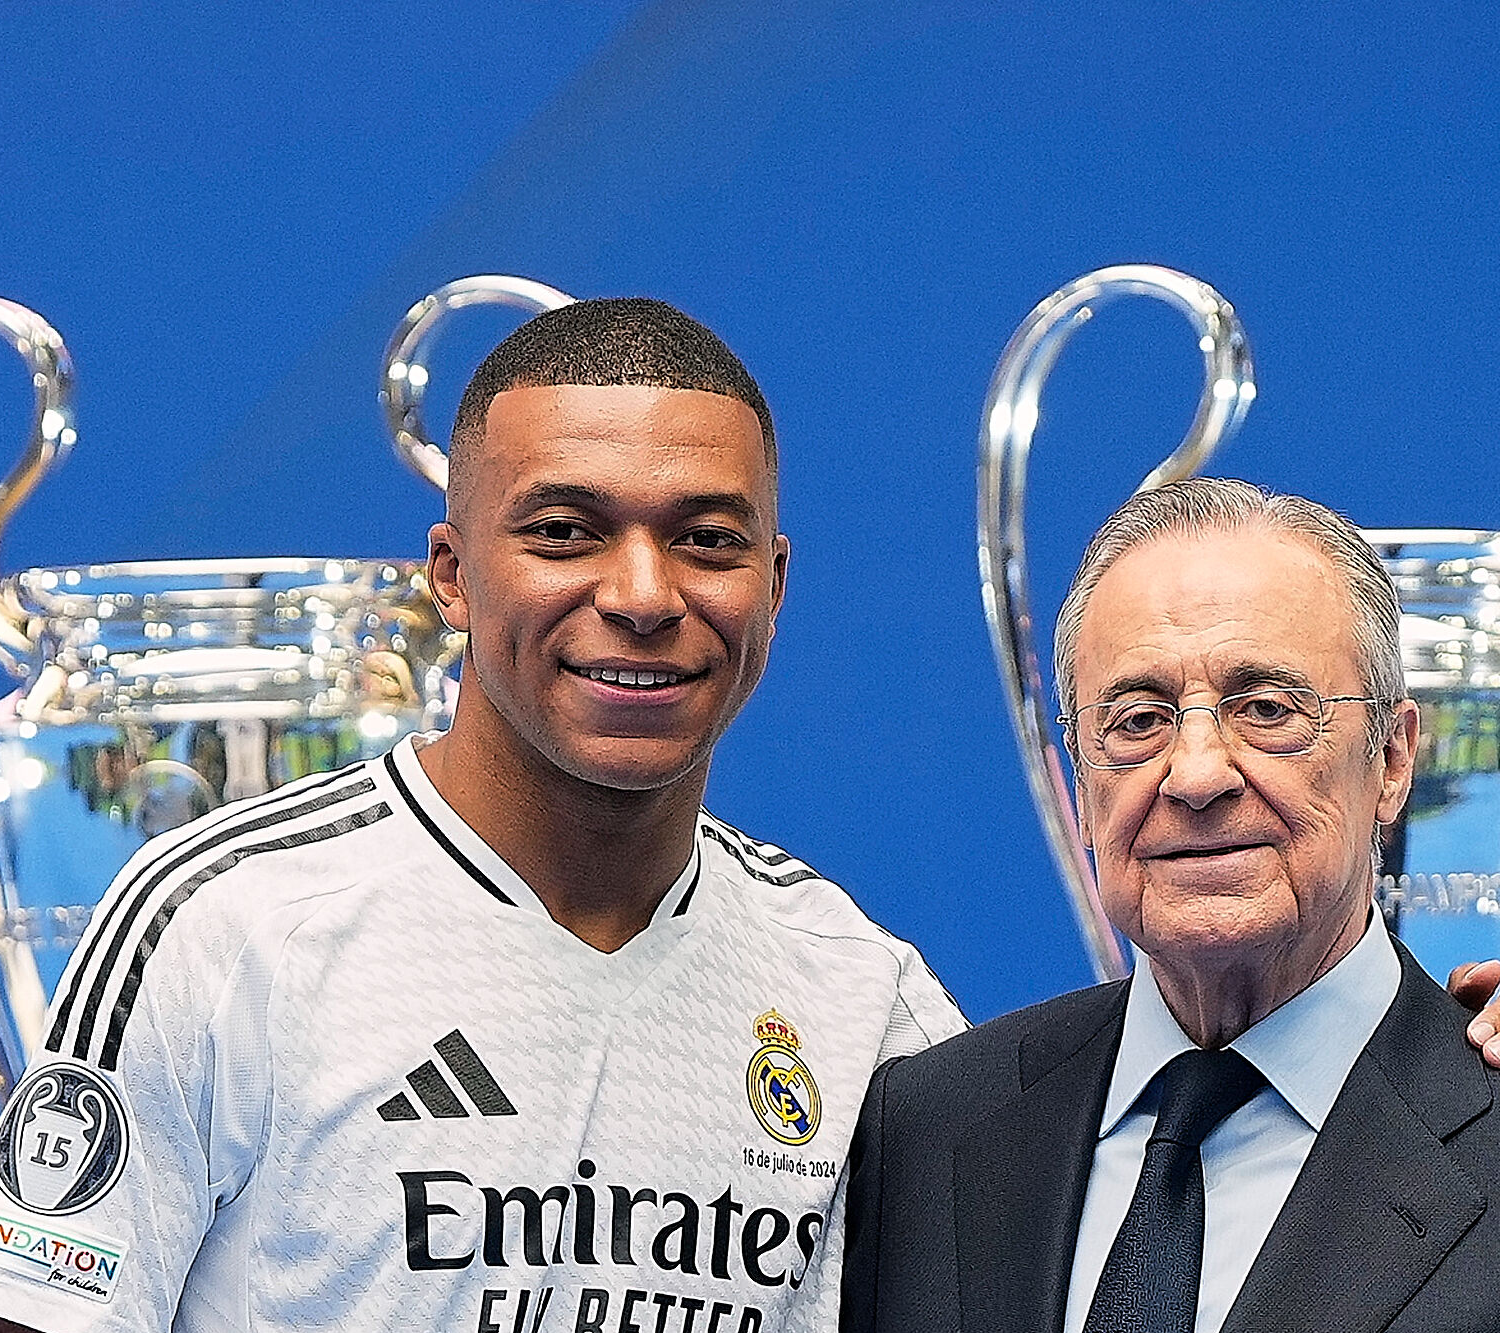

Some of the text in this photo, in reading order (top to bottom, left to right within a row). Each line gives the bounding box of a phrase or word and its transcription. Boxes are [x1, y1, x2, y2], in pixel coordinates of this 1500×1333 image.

[31, 1132, 72, 1168] 15
[742, 1147, 837, 1179] 16 de julio de 2024
[395, 1158, 826, 1291] Emirates
